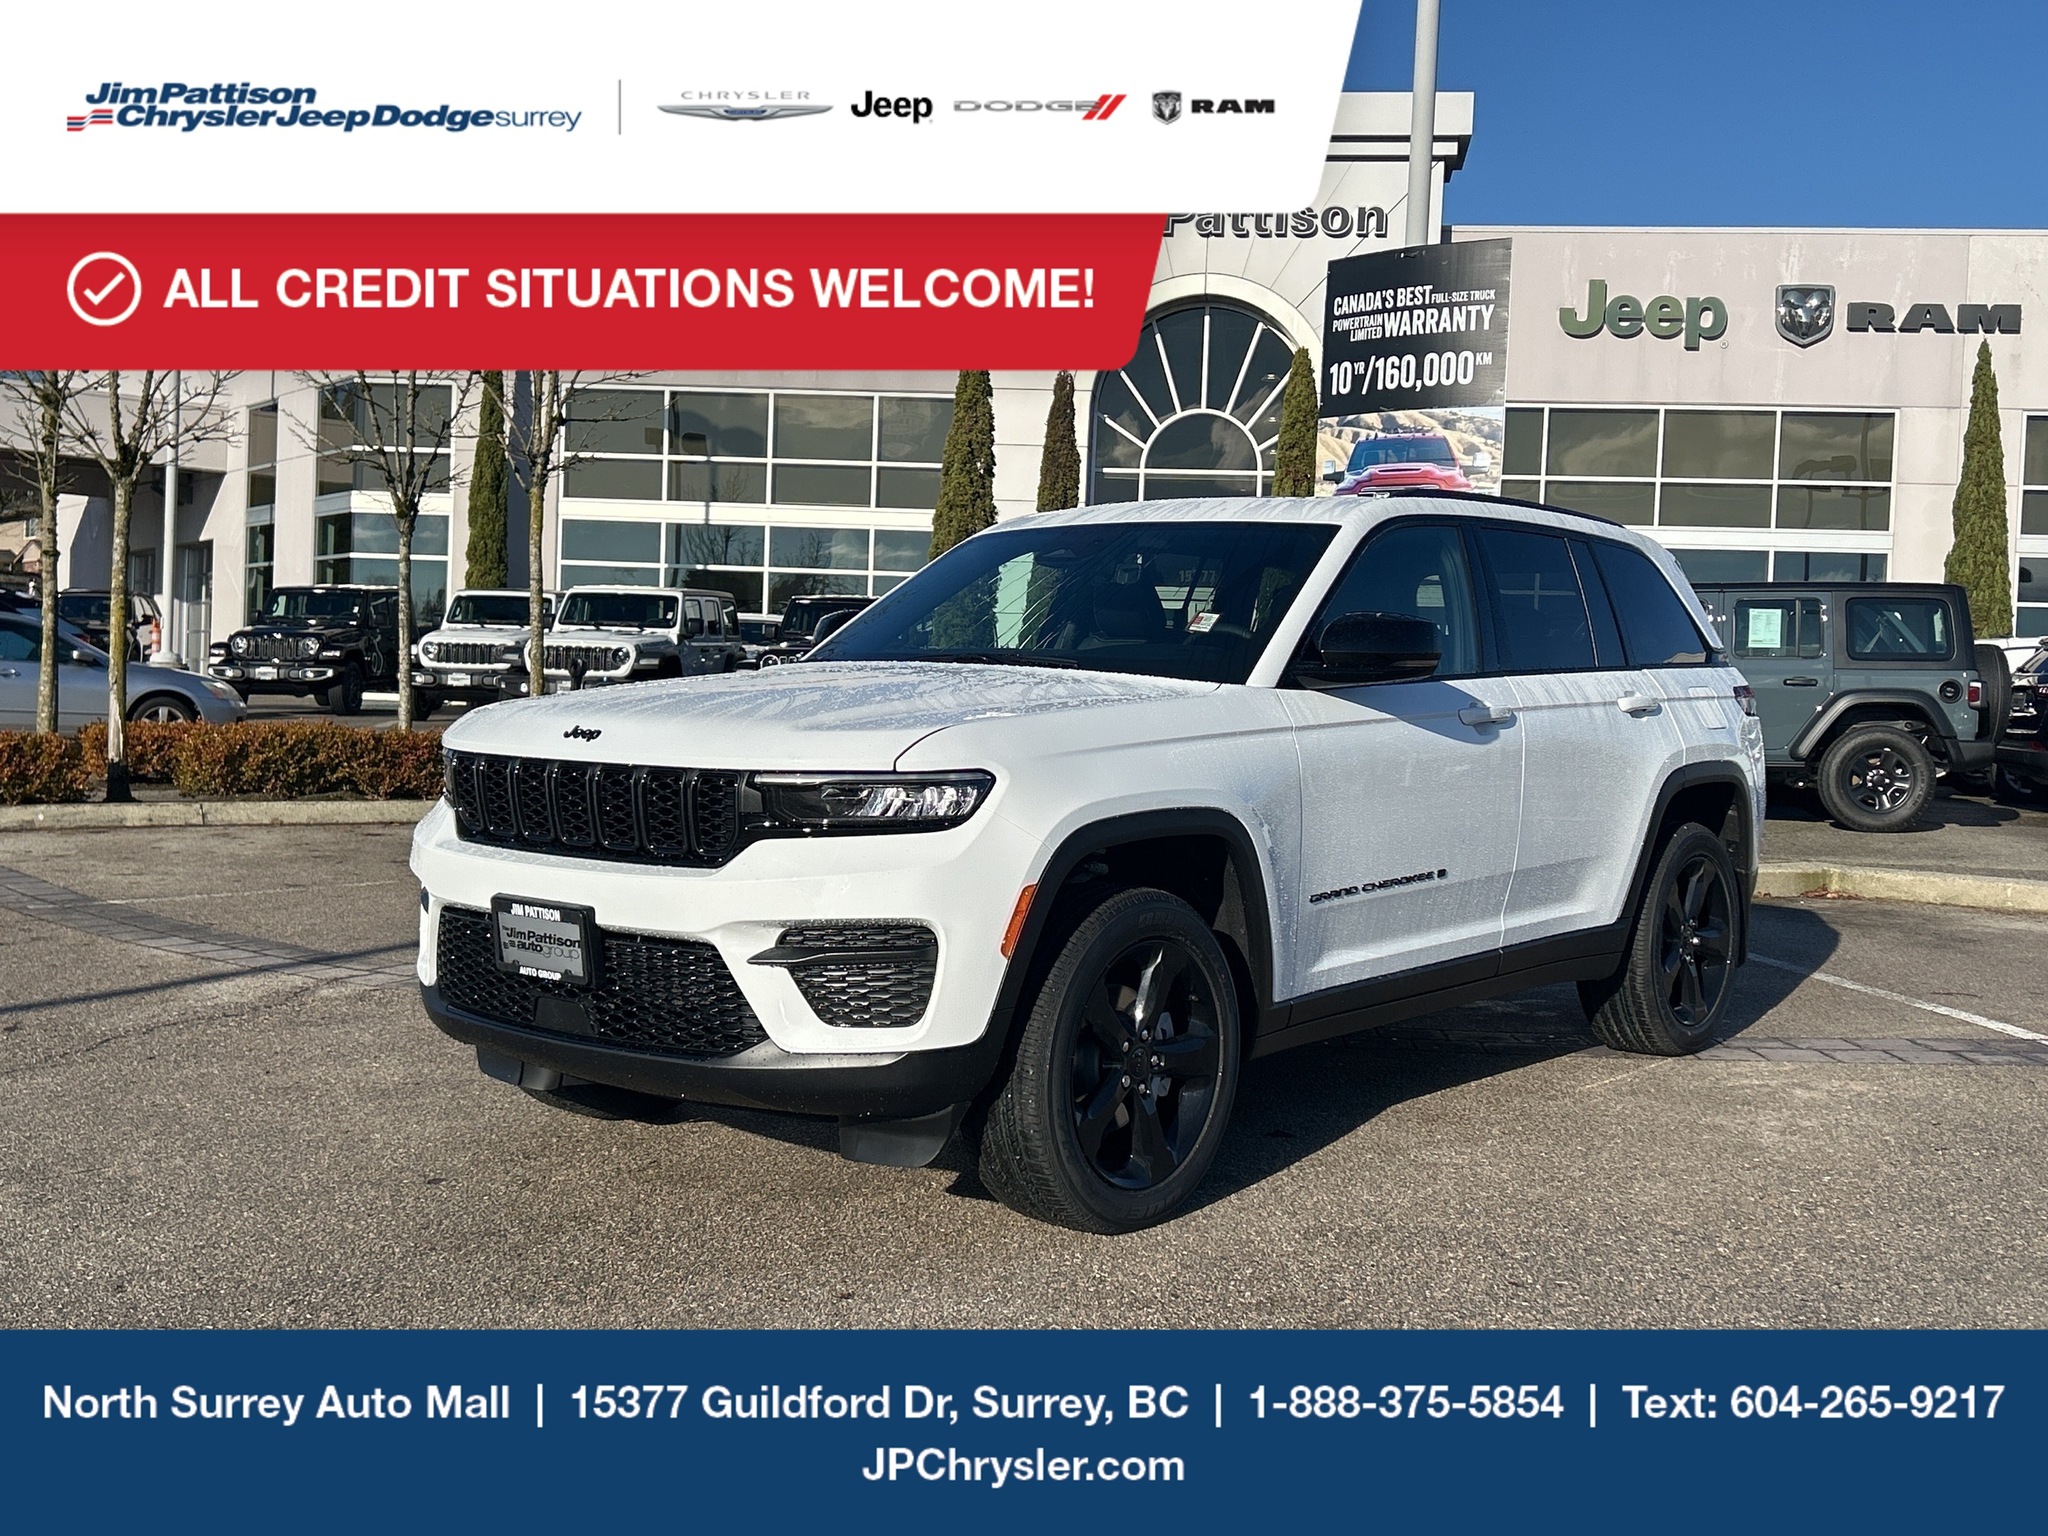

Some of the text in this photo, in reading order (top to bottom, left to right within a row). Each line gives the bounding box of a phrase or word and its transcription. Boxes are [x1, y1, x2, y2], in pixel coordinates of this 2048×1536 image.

[1333, 285, 1496, 317] CANADA'S BEST FULL-SIZE TRUCK
[1332, 313, 1383, 332] POWERTRAIN
[1384, 304, 1496, 338] WARRANTY
[1559, 279, 1729, 352] Jeep
[1847, 301, 2023, 335] RAM
[1350, 327, 1383, 342] LIMITED
[1179, 569, 1217, 583] 1577
[563, 725, 602, 742] Jeep
[1309, 871, 1436, 904] GRAND CHEROKEE
[511, 903, 561, 922] JIM PATTISON
[519, 966, 562, 981] AUTO GROUP
